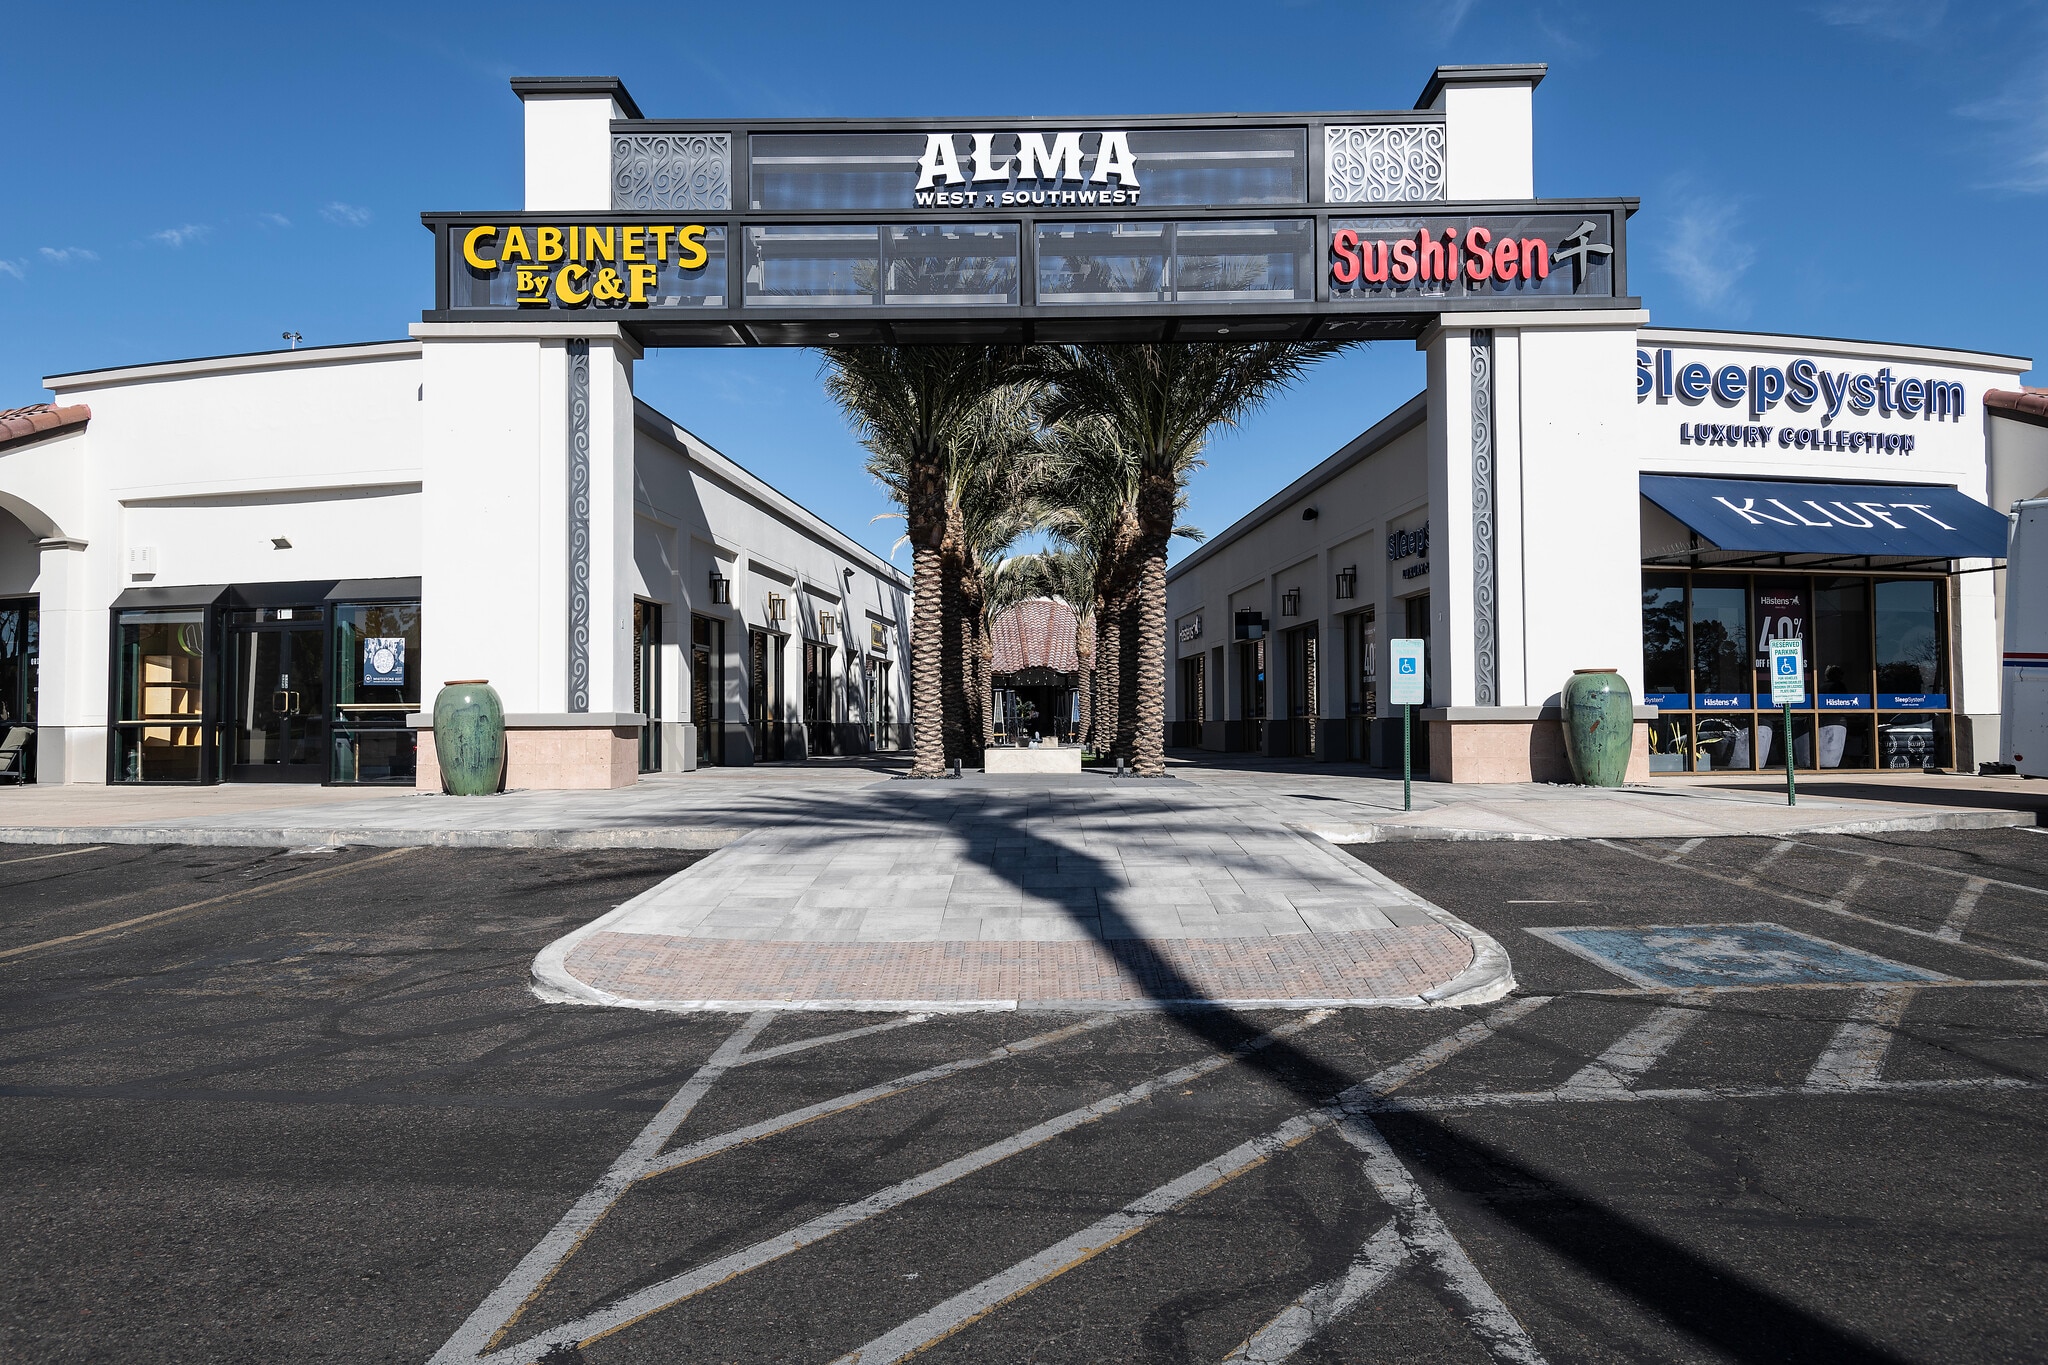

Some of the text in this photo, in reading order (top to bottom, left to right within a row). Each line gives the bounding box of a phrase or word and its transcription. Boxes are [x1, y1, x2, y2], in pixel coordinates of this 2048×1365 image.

[915, 131, 1141, 190] ALMA
[915, 191, 978, 205] WEST
[1001, 190, 1141, 205] SOUTHWEST
[463, 225, 708, 269] CABINETS
[517, 264, 657, 304] By C&F
[1682, 422, 1915, 451] LUXURY COLLECTION
[1712, 496, 1957, 531] KLUFT
[1760, 596, 1790, 605] Hästens
